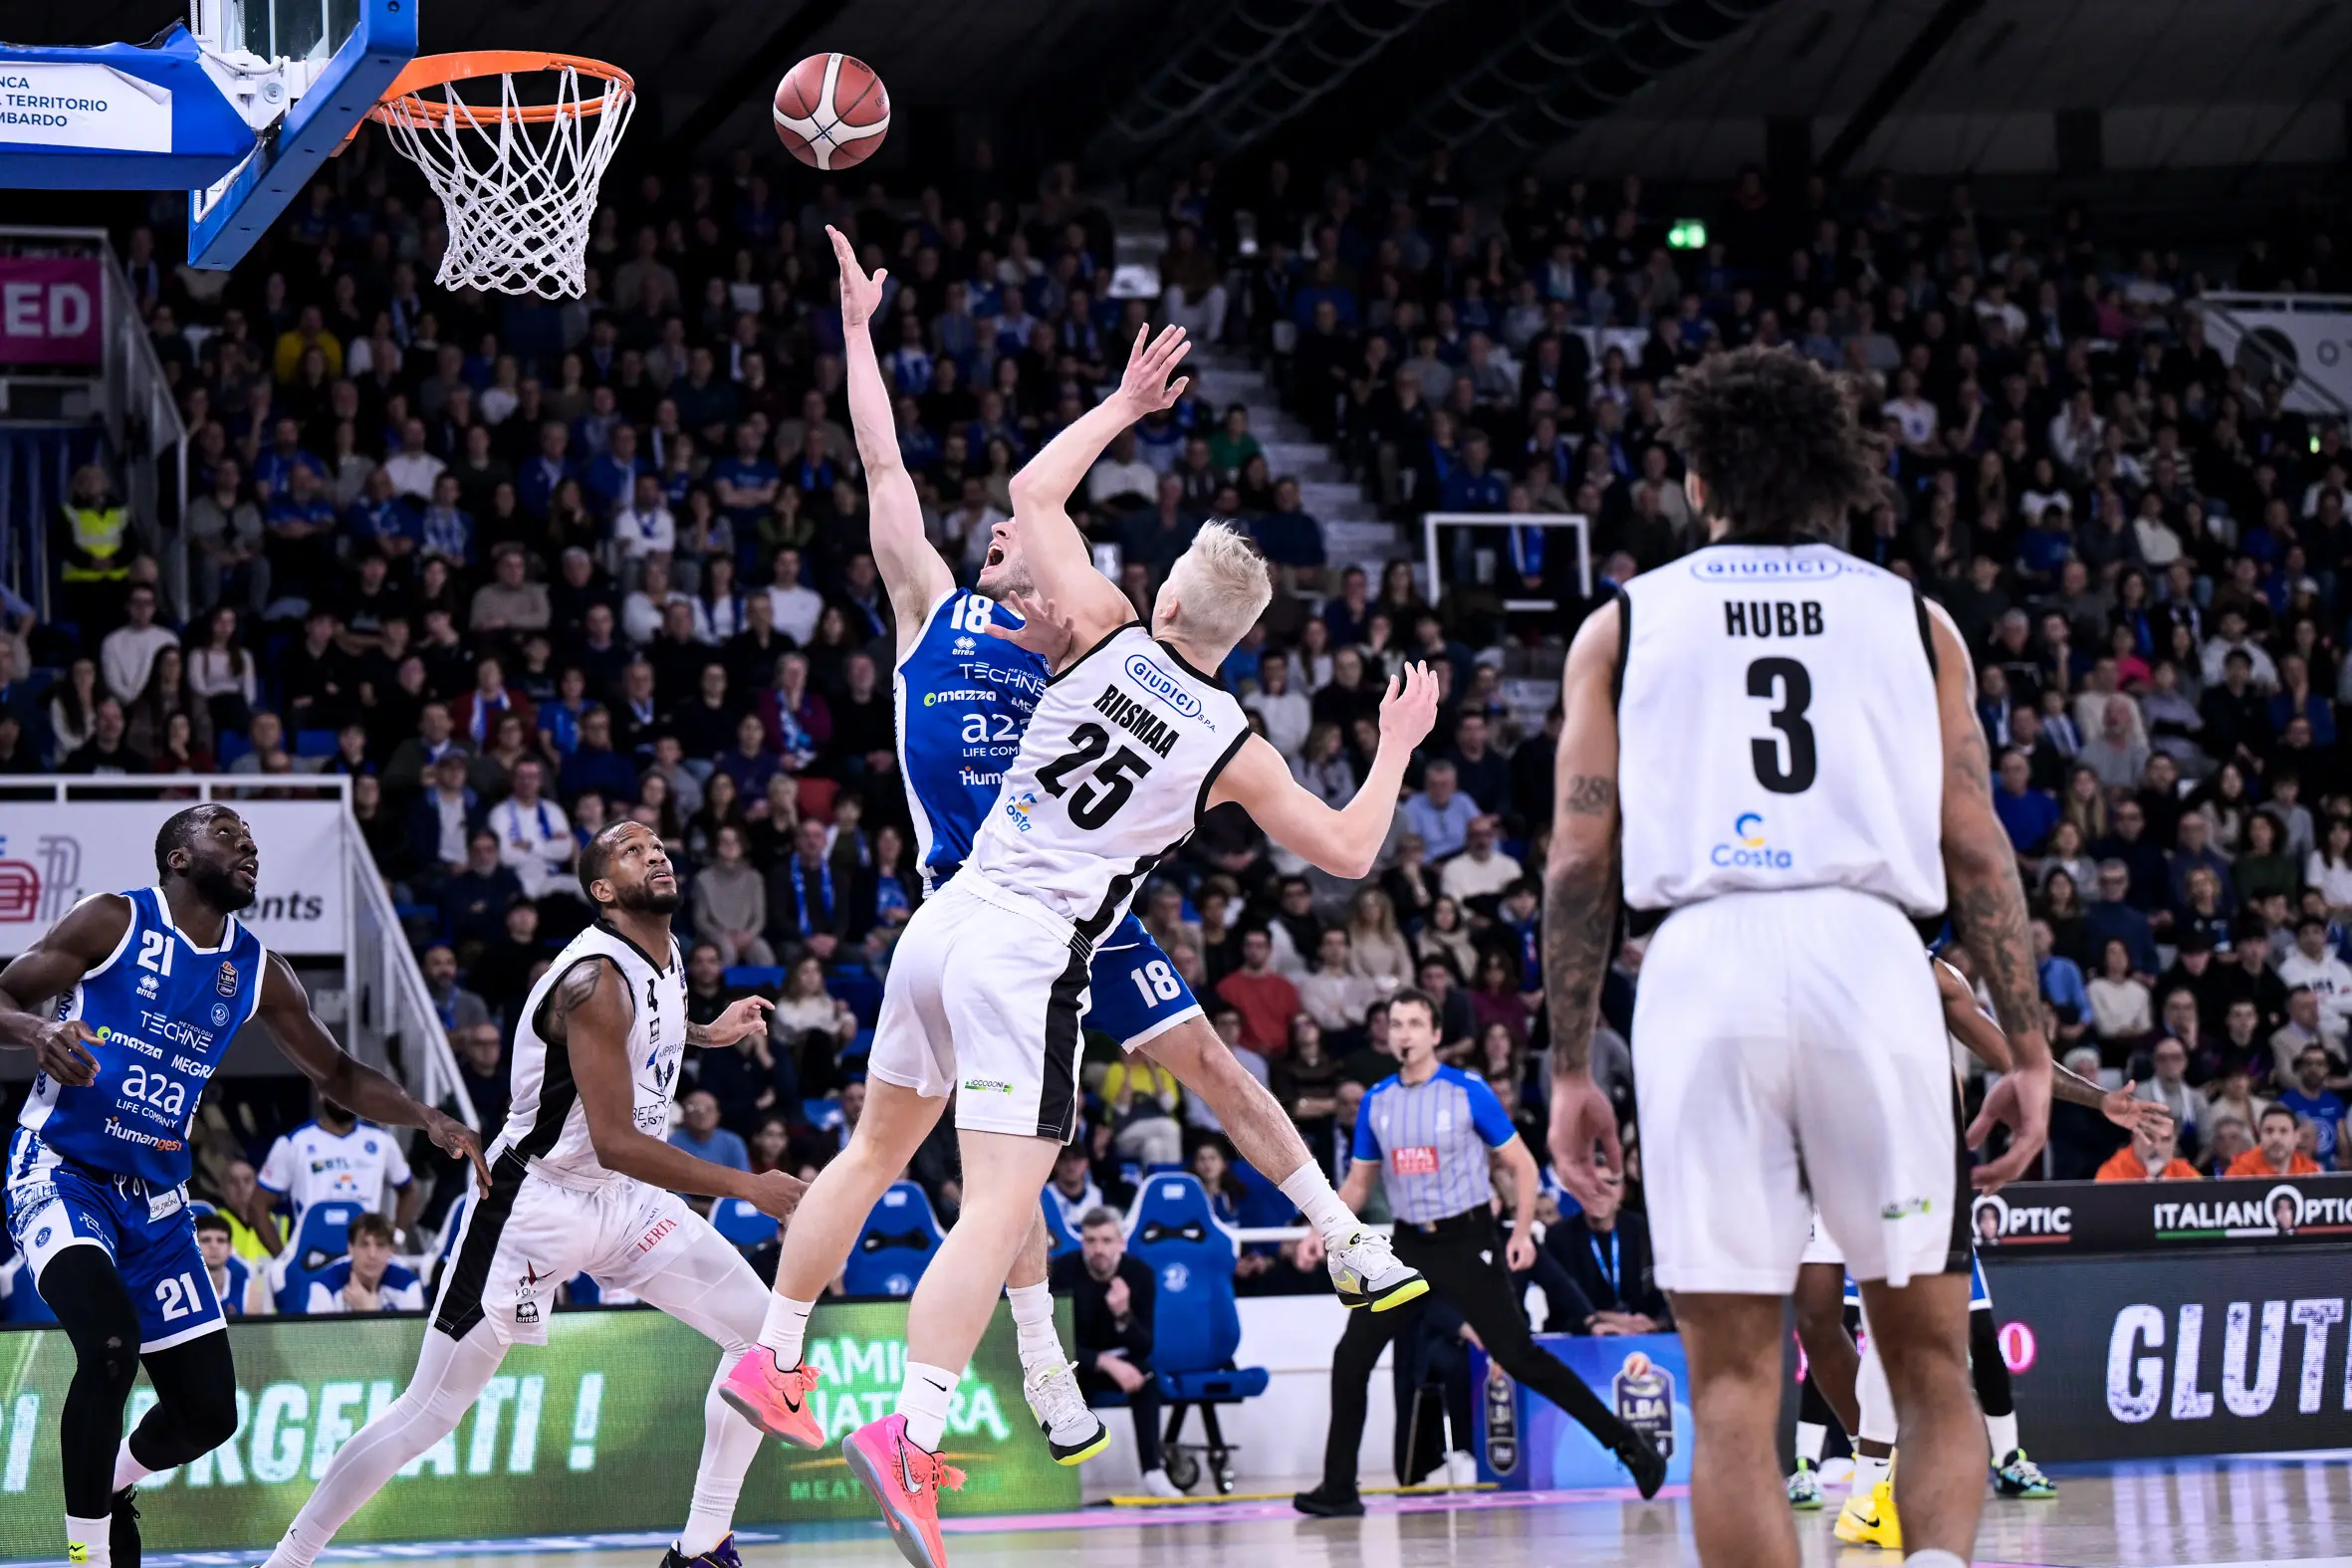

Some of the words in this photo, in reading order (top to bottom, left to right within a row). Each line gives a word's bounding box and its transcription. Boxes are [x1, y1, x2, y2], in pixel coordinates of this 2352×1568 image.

[6, 94, 108, 112] TERRITORIO
[1708, 560, 1826, 573] GIUDICI
[950, 594, 995, 634] 18
[1725, 600, 1824, 638] HUBB
[937, 689, 997, 703] mazza
[1133, 662, 1195, 711] GIUDICI
[1092, 683, 1180, 760] RIISMAA
[1747, 657, 1817, 794] 3
[963, 749, 987, 758] LIFE
[990, 747, 1020, 757] COM
[1036, 723, 1152, 830] 25
[1711, 844, 1792, 868] Costa
[136, 929, 175, 978] 21
[647, 979, 659, 1012] 4
[1130, 960, 1181, 1009] 18
[111, 1031, 164, 1059] mazza
[178, 1020, 214, 1038] METROLOGIA
[121, 1064, 186, 1116] a2a
[116, 1098, 140, 1114] LIFE
[141, 1106, 179, 1129] COMPANY
[637, 1218, 678, 1253] LERTA
[155, 1271, 203, 1322] 21
[2106, 1297, 2352, 1424] GLUT
[1622, 1399, 1668, 1421] LBA
